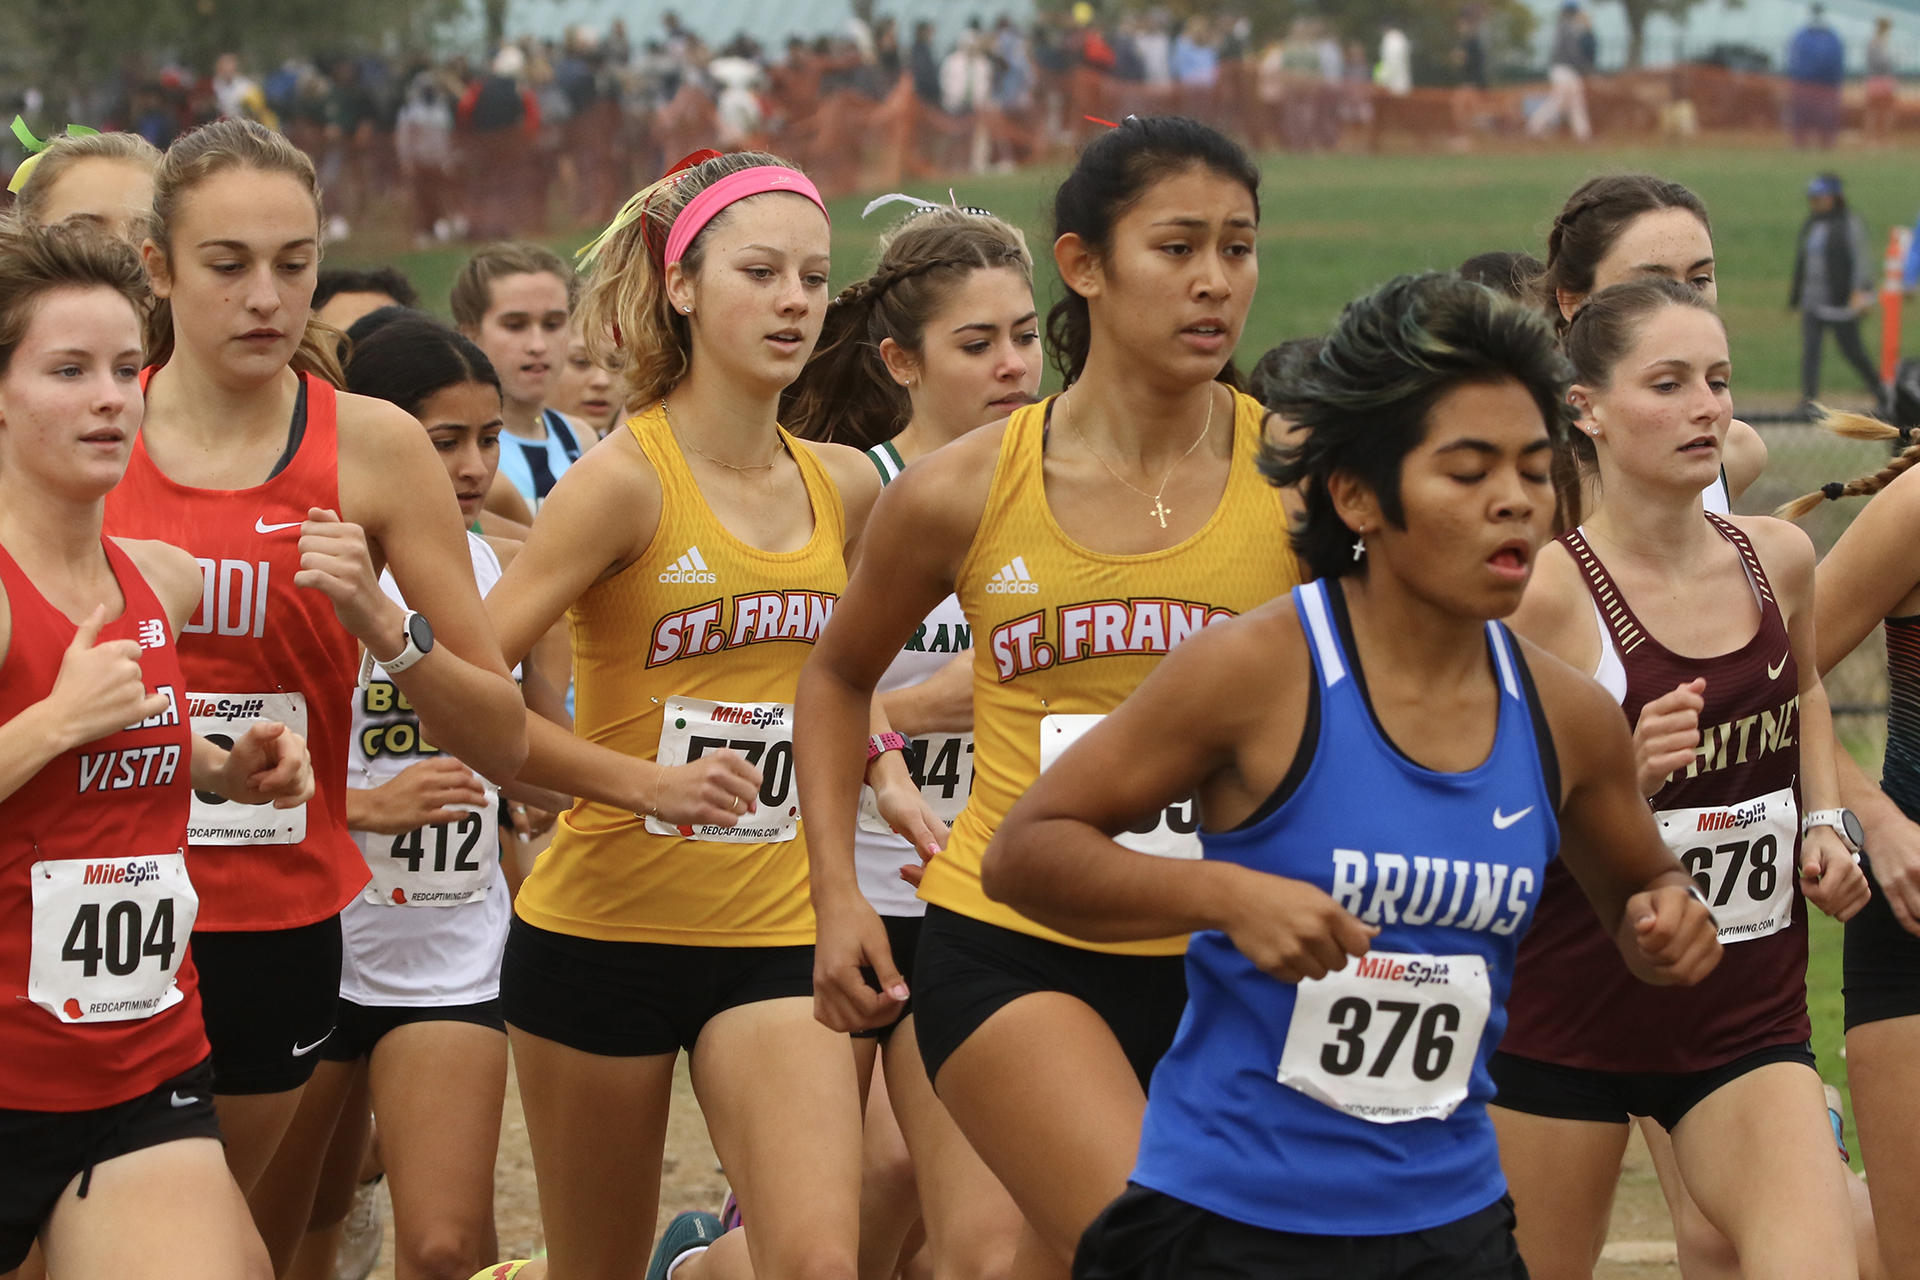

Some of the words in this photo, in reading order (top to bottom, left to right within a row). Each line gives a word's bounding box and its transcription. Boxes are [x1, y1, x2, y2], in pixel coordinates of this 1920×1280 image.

[658, 570, 717, 584] adidas
[985, 580, 1039, 594] adidas
[182, 558, 270, 638] ODI
[645, 598, 727, 670] ST.
[723, 589, 841, 651] FRAN
[903, 622, 971, 654] RAN
[990, 609, 1055, 683] ST.
[1056, 597, 1239, 666] FRAN
[189, 699, 264, 722] ileSplit
[711, 706, 785, 730] MileSplit
[1665, 694, 1800, 784] HITNE
[78, 745, 181, 793] VISTA
[701, 825, 779, 838] REDCAPTIMING.COM
[1696, 802, 1767, 832] MileSplit
[187, 828, 276, 839] EDCAPTIMING.COM
[390, 811, 483, 872] 412
[83, 861, 160, 888] MileSplit
[1680, 834, 1777, 908] 678
[1330, 848, 1535, 937] BRUINS
[61, 898, 176, 978] 404
[1717, 919, 1775, 938] APTIMING.COM
[1356, 957, 1450, 988] MileSplit
[1319, 996, 1461, 1083] 376
